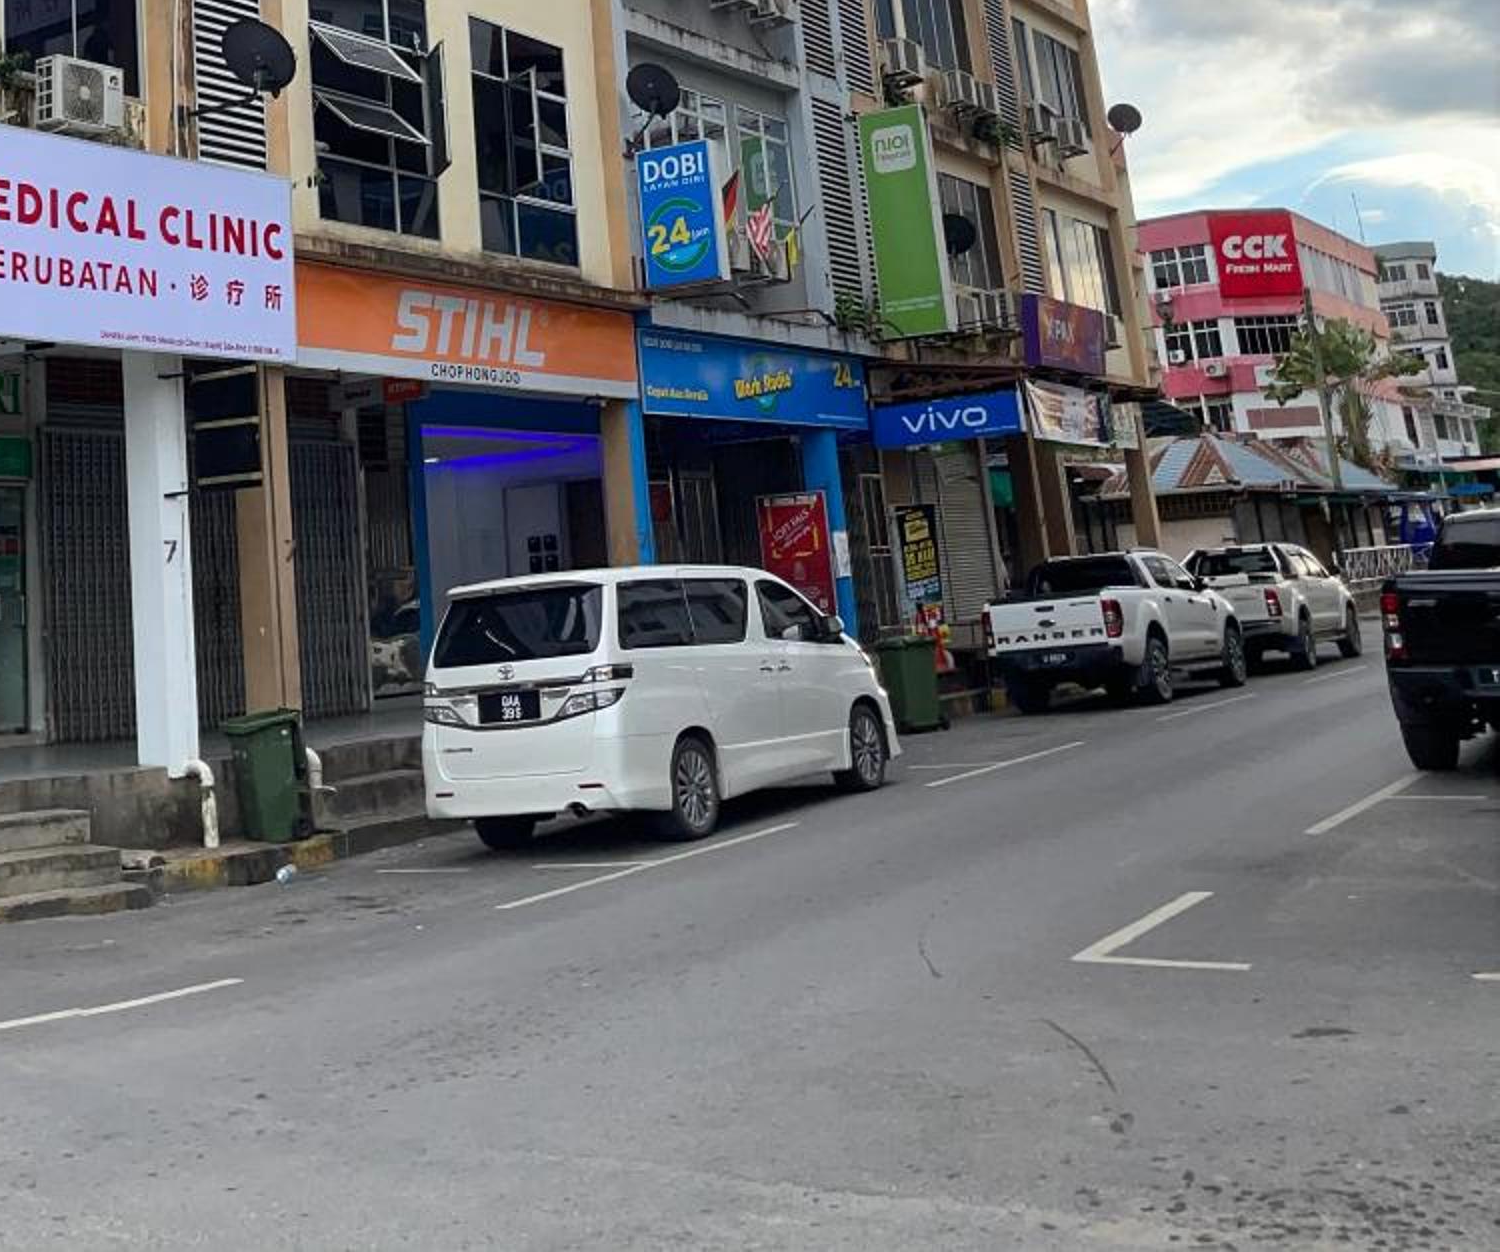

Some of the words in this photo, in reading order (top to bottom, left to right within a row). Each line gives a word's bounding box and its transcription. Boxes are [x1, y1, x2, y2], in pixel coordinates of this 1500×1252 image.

[643, 151, 704, 183] DOBI
[159, 205, 284, 260] CLINIC
[648, 216, 691, 254] 24
[1222, 235, 1288, 259] CCK
[190, 274, 281, 311] 诊疗所
[391, 291, 546, 367] STIHL
[902, 406, 987, 433] vivo
[164, 540, 177, 563] 7
